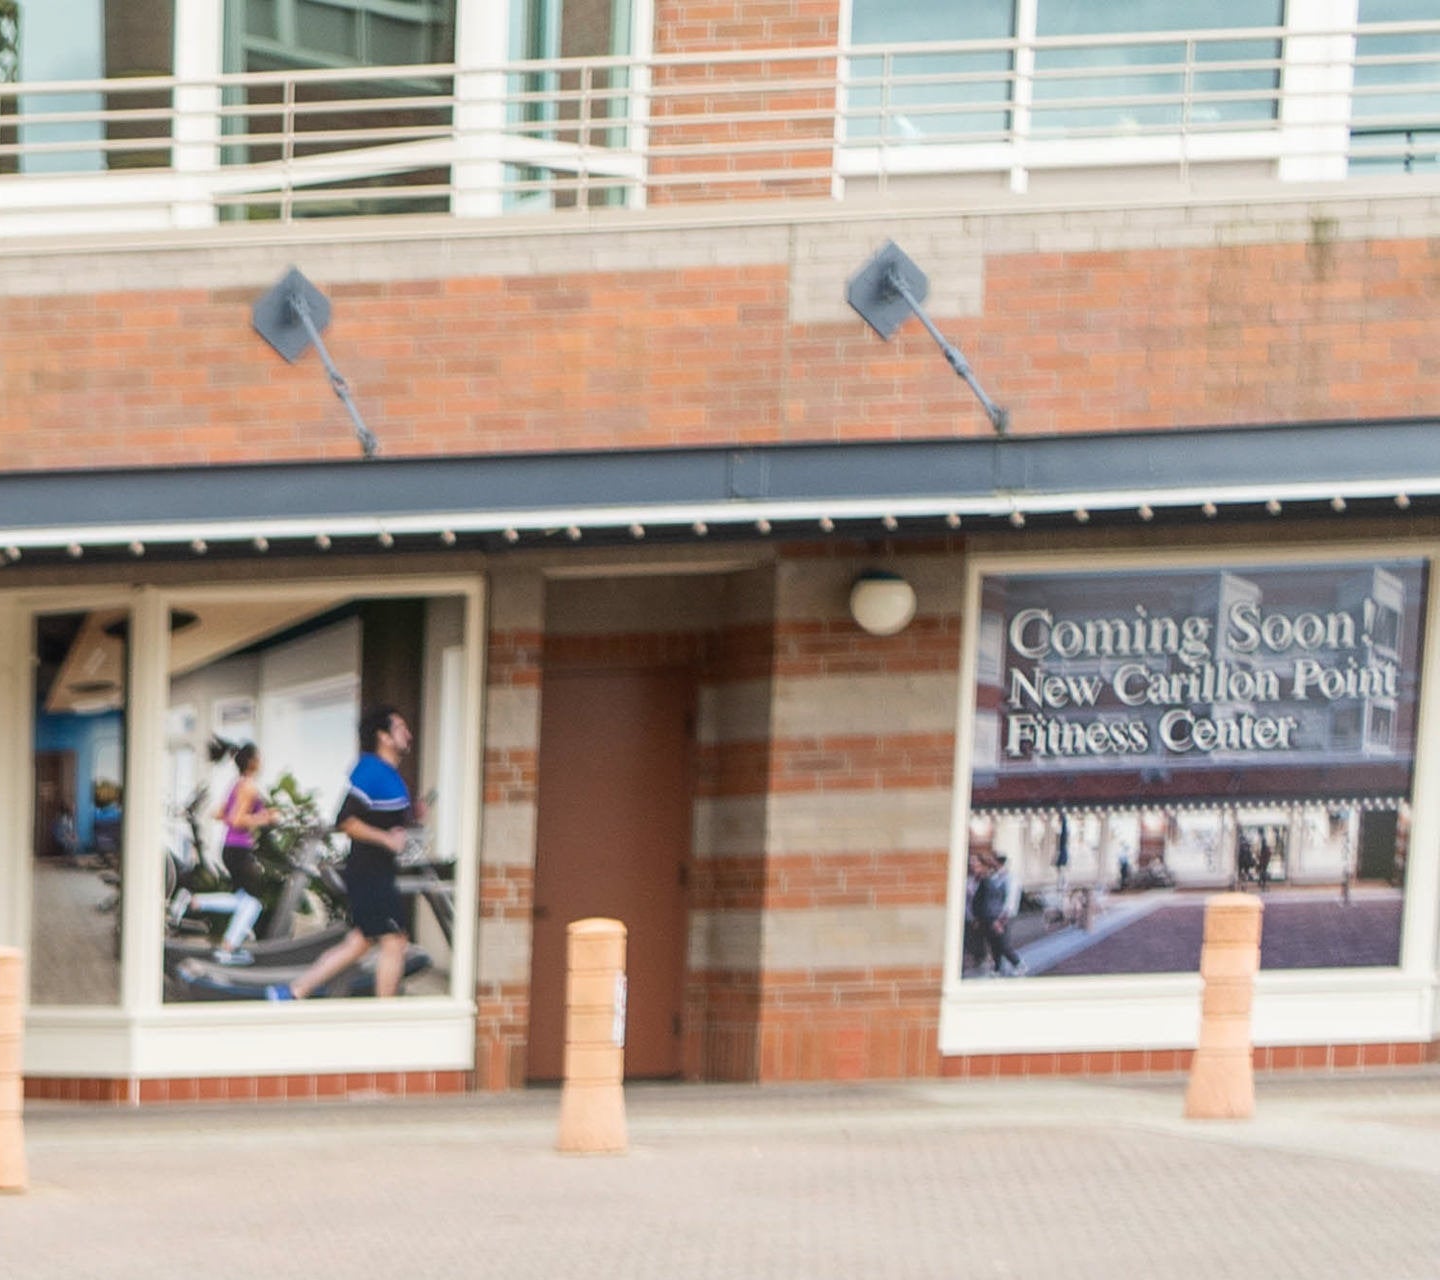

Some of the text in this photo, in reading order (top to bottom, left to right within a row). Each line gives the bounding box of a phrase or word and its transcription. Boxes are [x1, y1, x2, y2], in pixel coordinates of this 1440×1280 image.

[1009, 597, 1375, 666] Coming Soon!
[1009, 655, 1399, 708] New Carillon Point
[1007, 708, 1298, 758] Fitness Center
